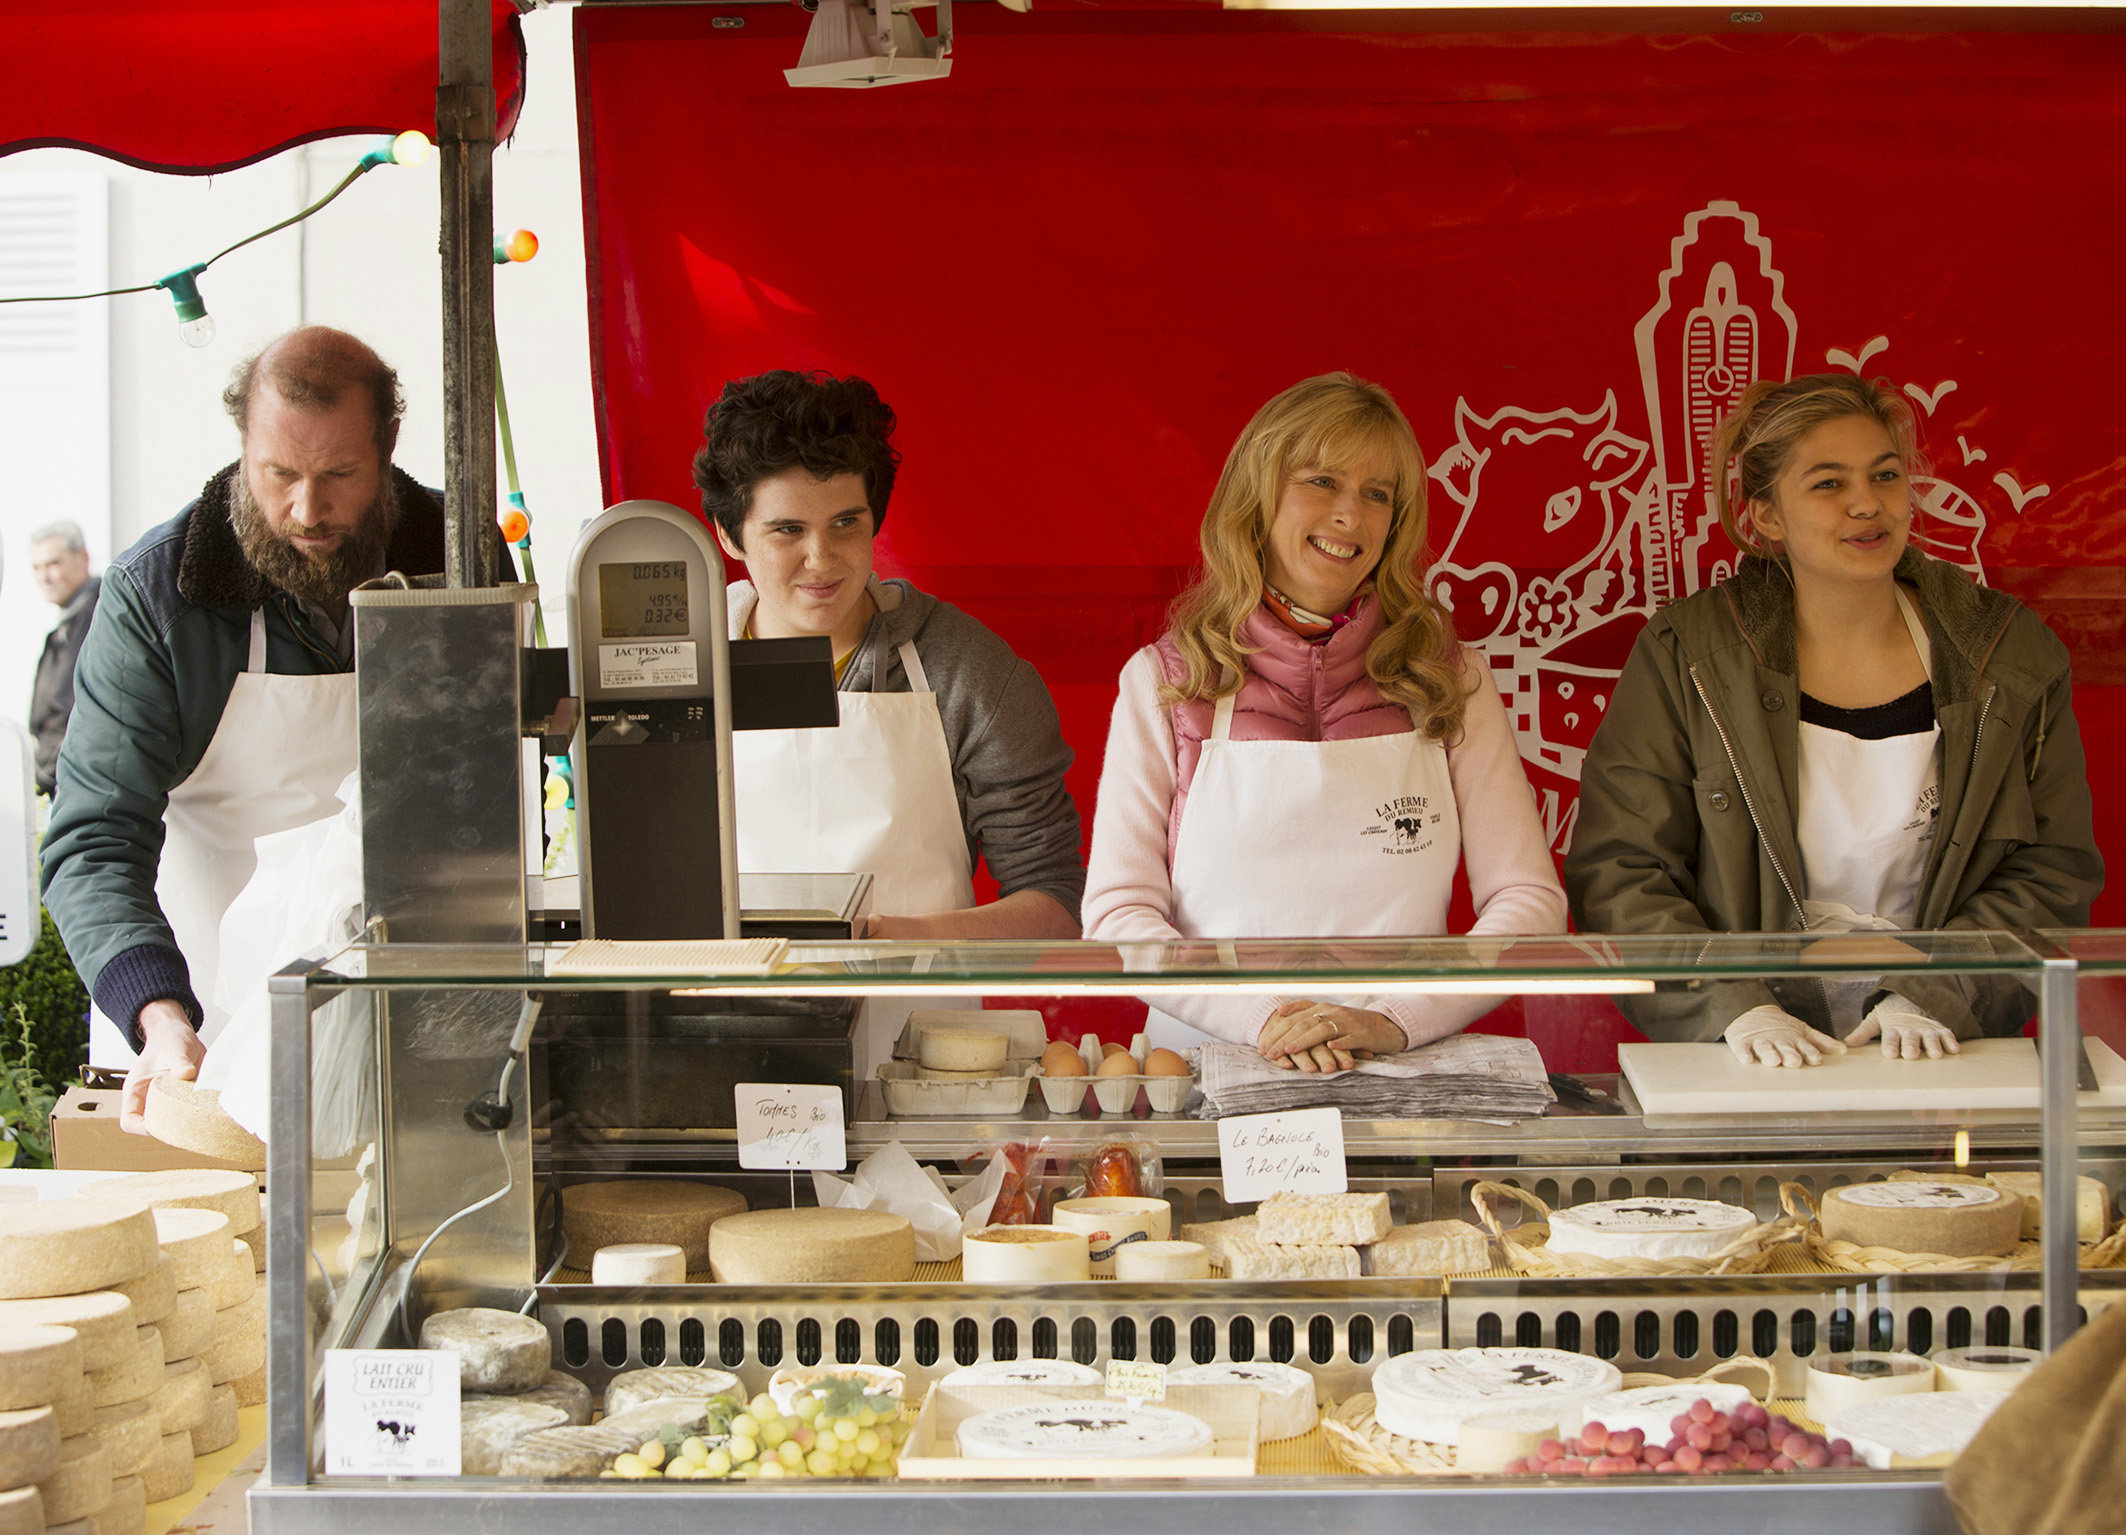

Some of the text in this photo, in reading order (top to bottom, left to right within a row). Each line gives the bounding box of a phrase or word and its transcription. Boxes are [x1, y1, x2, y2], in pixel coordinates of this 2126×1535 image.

[614, 646, 681, 657] JAC'PESAGE
[627, 713, 650, 721] TOLEDO
[1375, 796, 1429, 817] LA FERME
[1384, 811, 1397, 822] DU
[756, 1098, 797, 1119] TOMMES
[363, 1362, 424, 1375] LAIT CRU
[370, 1376, 418, 1389] ENTIER
